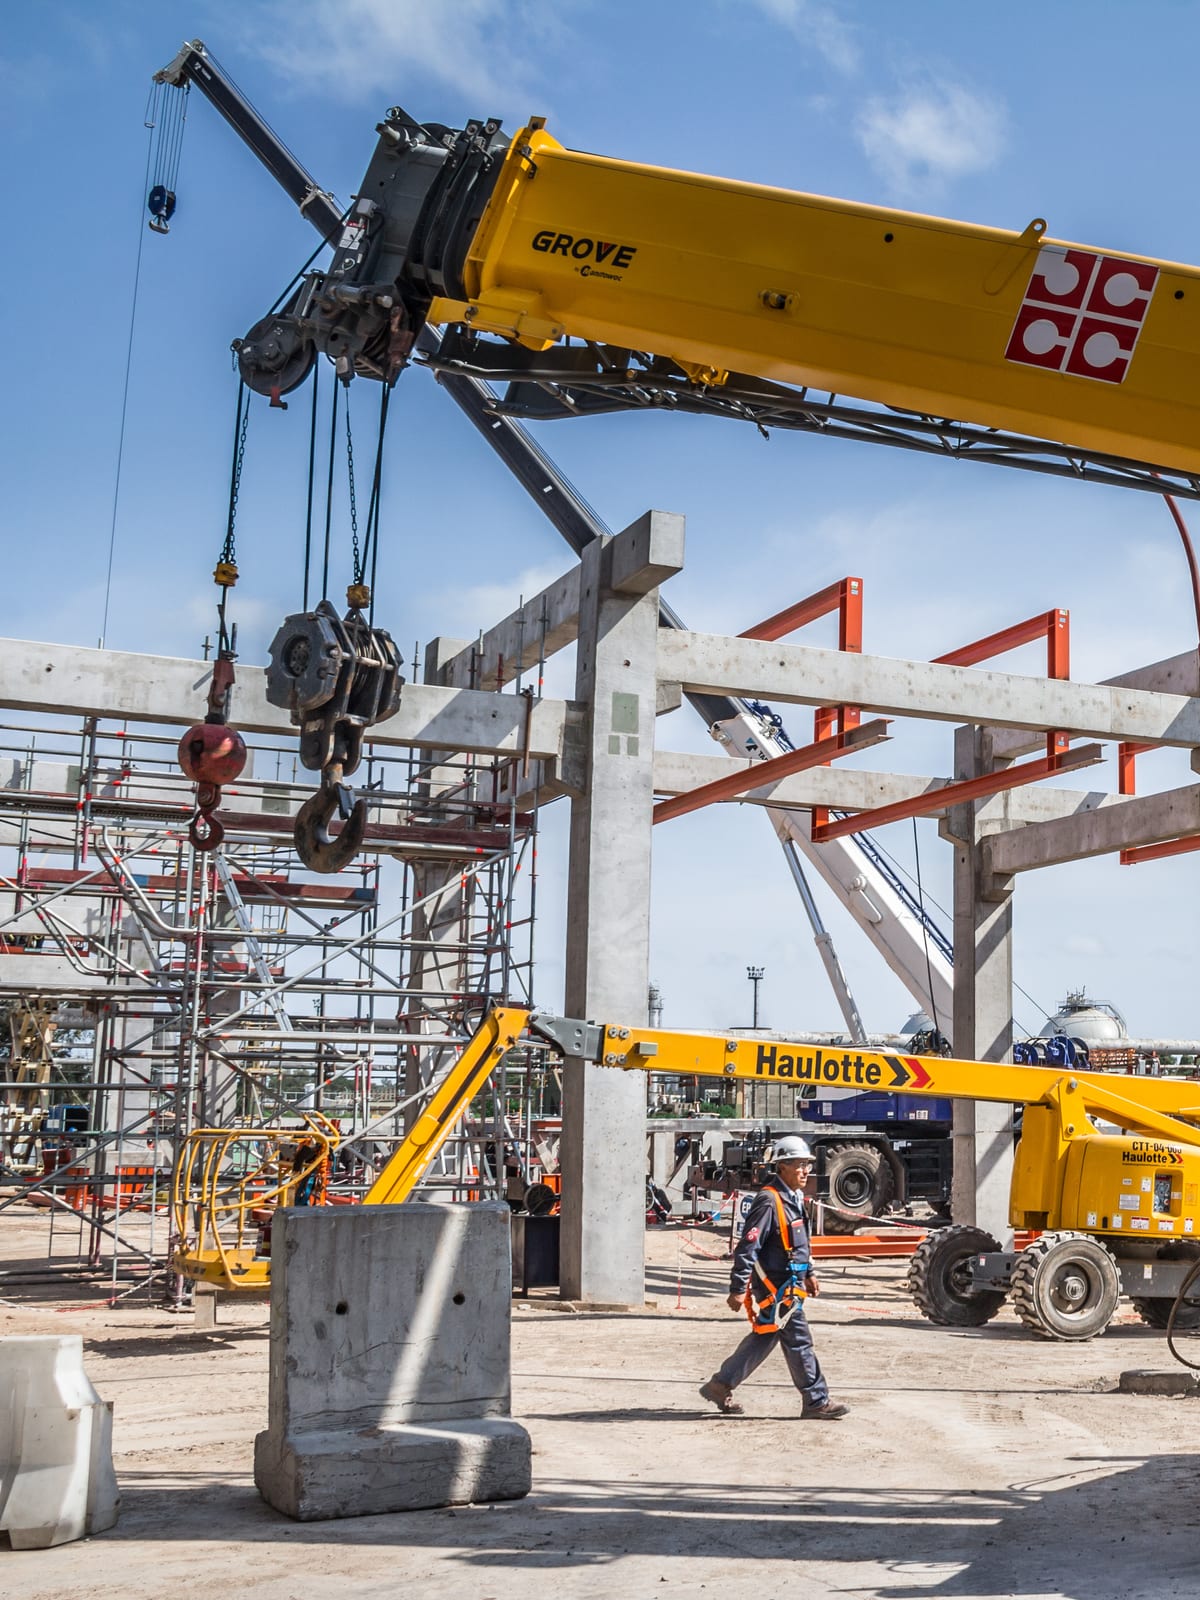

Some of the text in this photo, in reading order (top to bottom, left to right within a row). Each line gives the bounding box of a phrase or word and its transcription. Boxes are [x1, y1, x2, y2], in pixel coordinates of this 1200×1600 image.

[532, 230, 637, 269] GROVE
[755, 1045, 882, 1085] Haulotte
[1122, 1151, 1168, 1163] Haulotte
